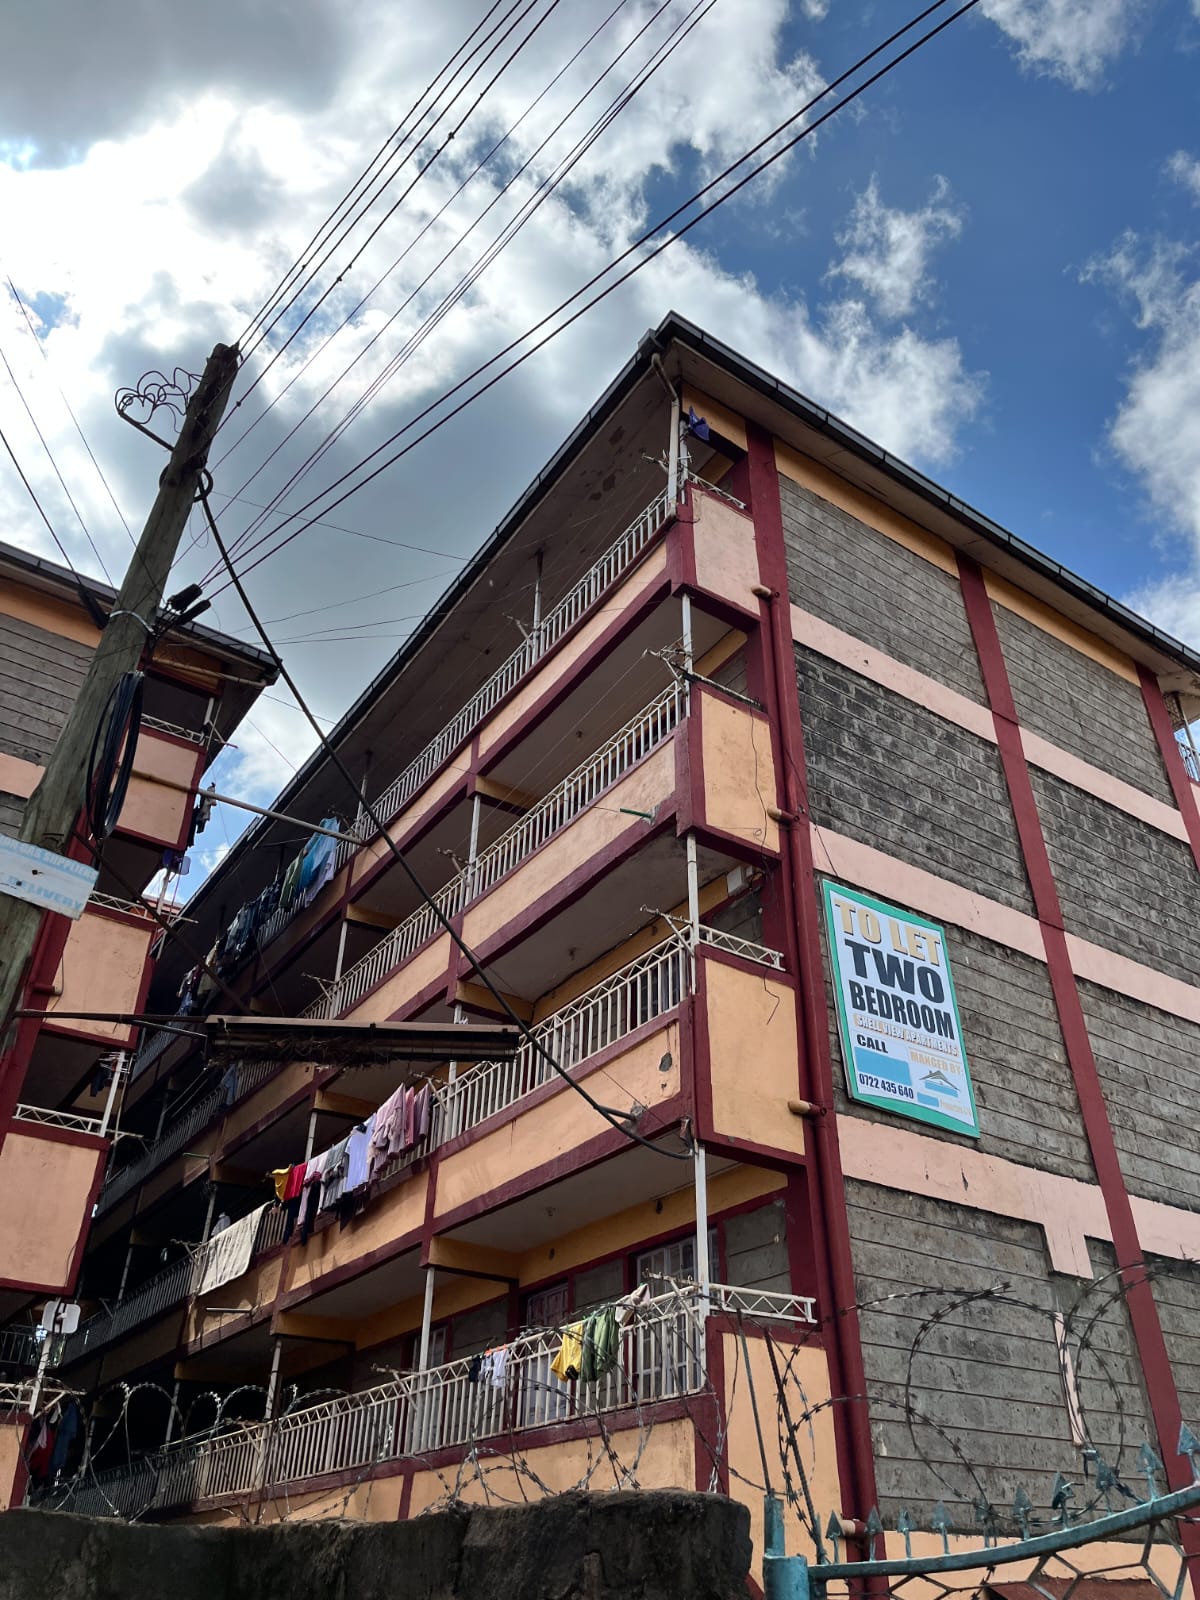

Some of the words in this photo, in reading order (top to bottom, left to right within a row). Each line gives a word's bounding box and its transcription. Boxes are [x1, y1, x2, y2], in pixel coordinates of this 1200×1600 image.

[834, 897, 882, 944] TO
[887, 918, 940, 967] LET
[844, 938, 945, 1004] TWO
[848, 980, 955, 1040] BEDROOM
[855, 1014, 883, 1034] SHELL
[882, 1021, 905, 1040] VIEW
[905, 1028, 959, 1057] APARTMENTS
[856, 1033, 889, 1054] CALL
[859, 1073, 880, 1090] 0722
[881, 1079, 898, 1096] 435
[898, 1082, 915, 1100] 640
